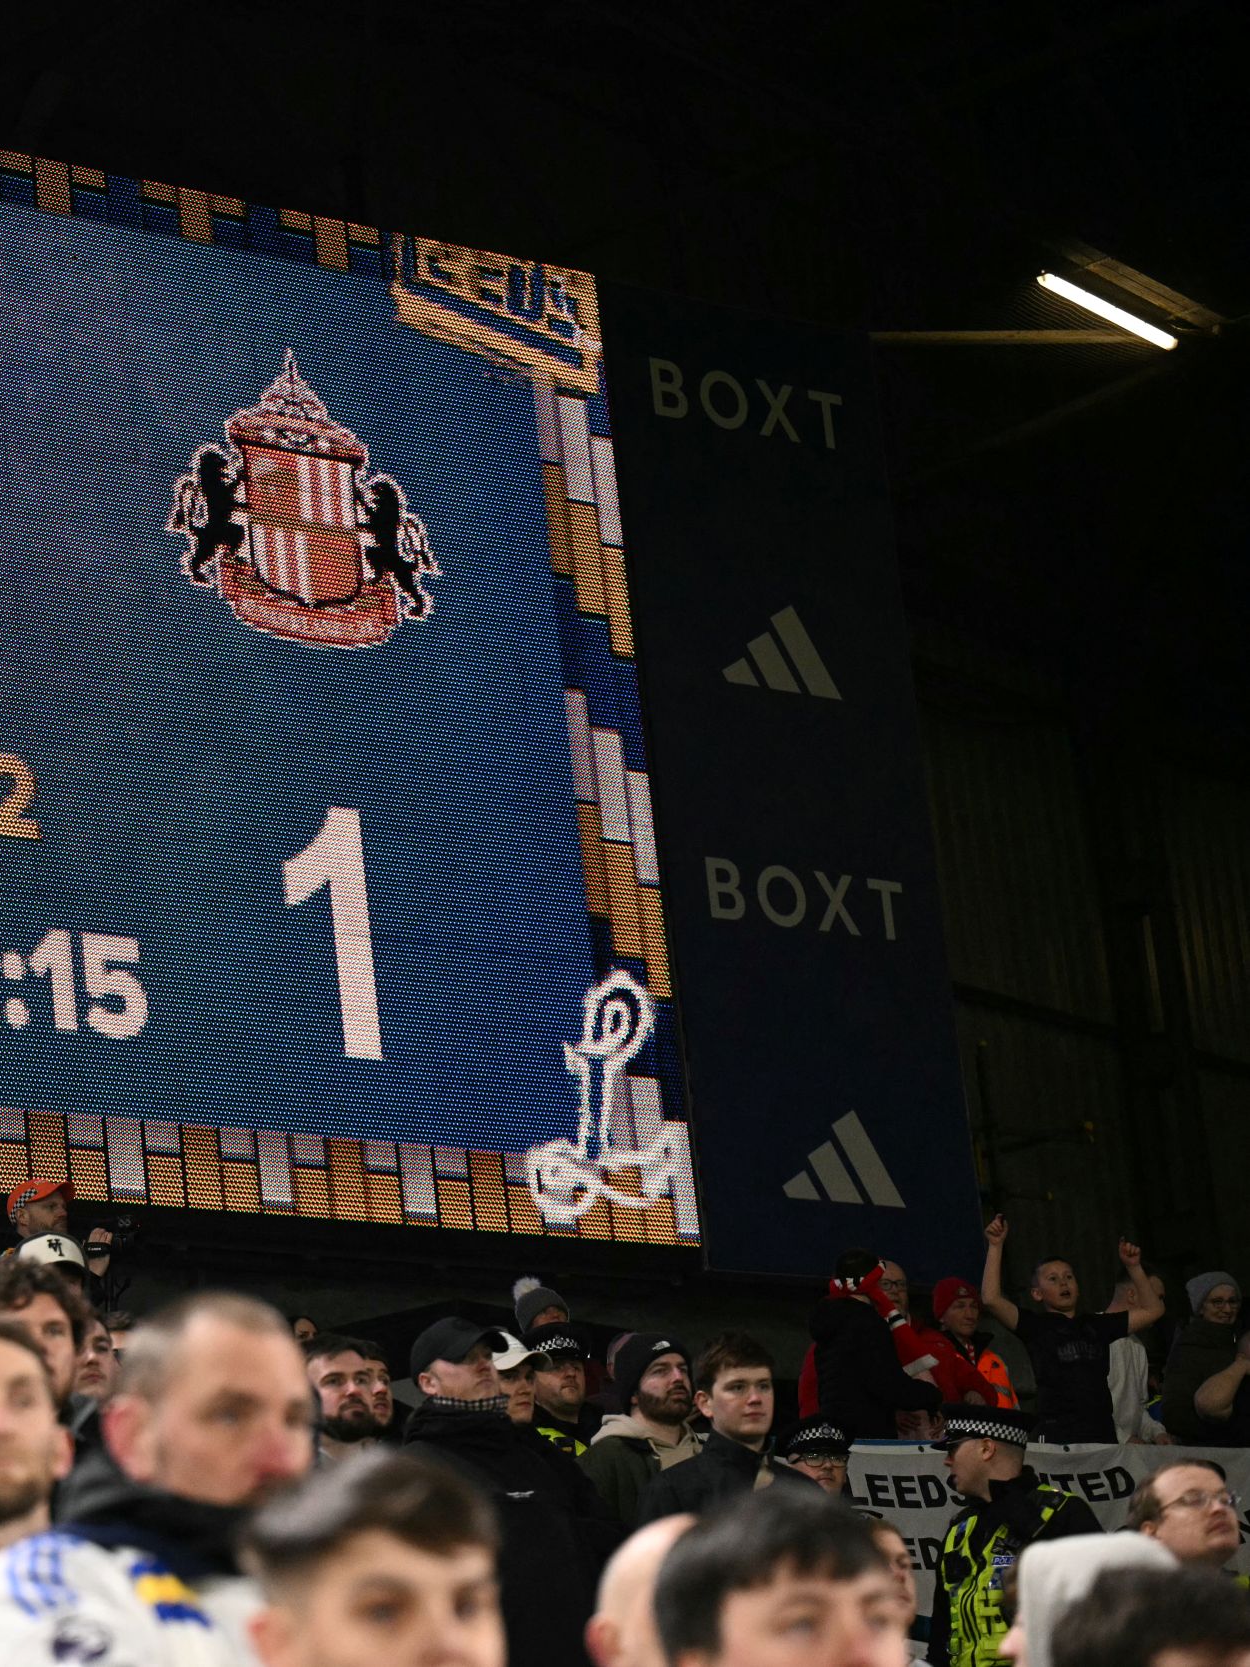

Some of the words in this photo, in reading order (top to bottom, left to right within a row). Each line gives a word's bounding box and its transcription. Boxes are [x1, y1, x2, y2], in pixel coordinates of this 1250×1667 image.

[649, 356, 843, 450] BOXT
[282, 806, 384, 1060] 1
[705, 856, 902, 941] BOXT
